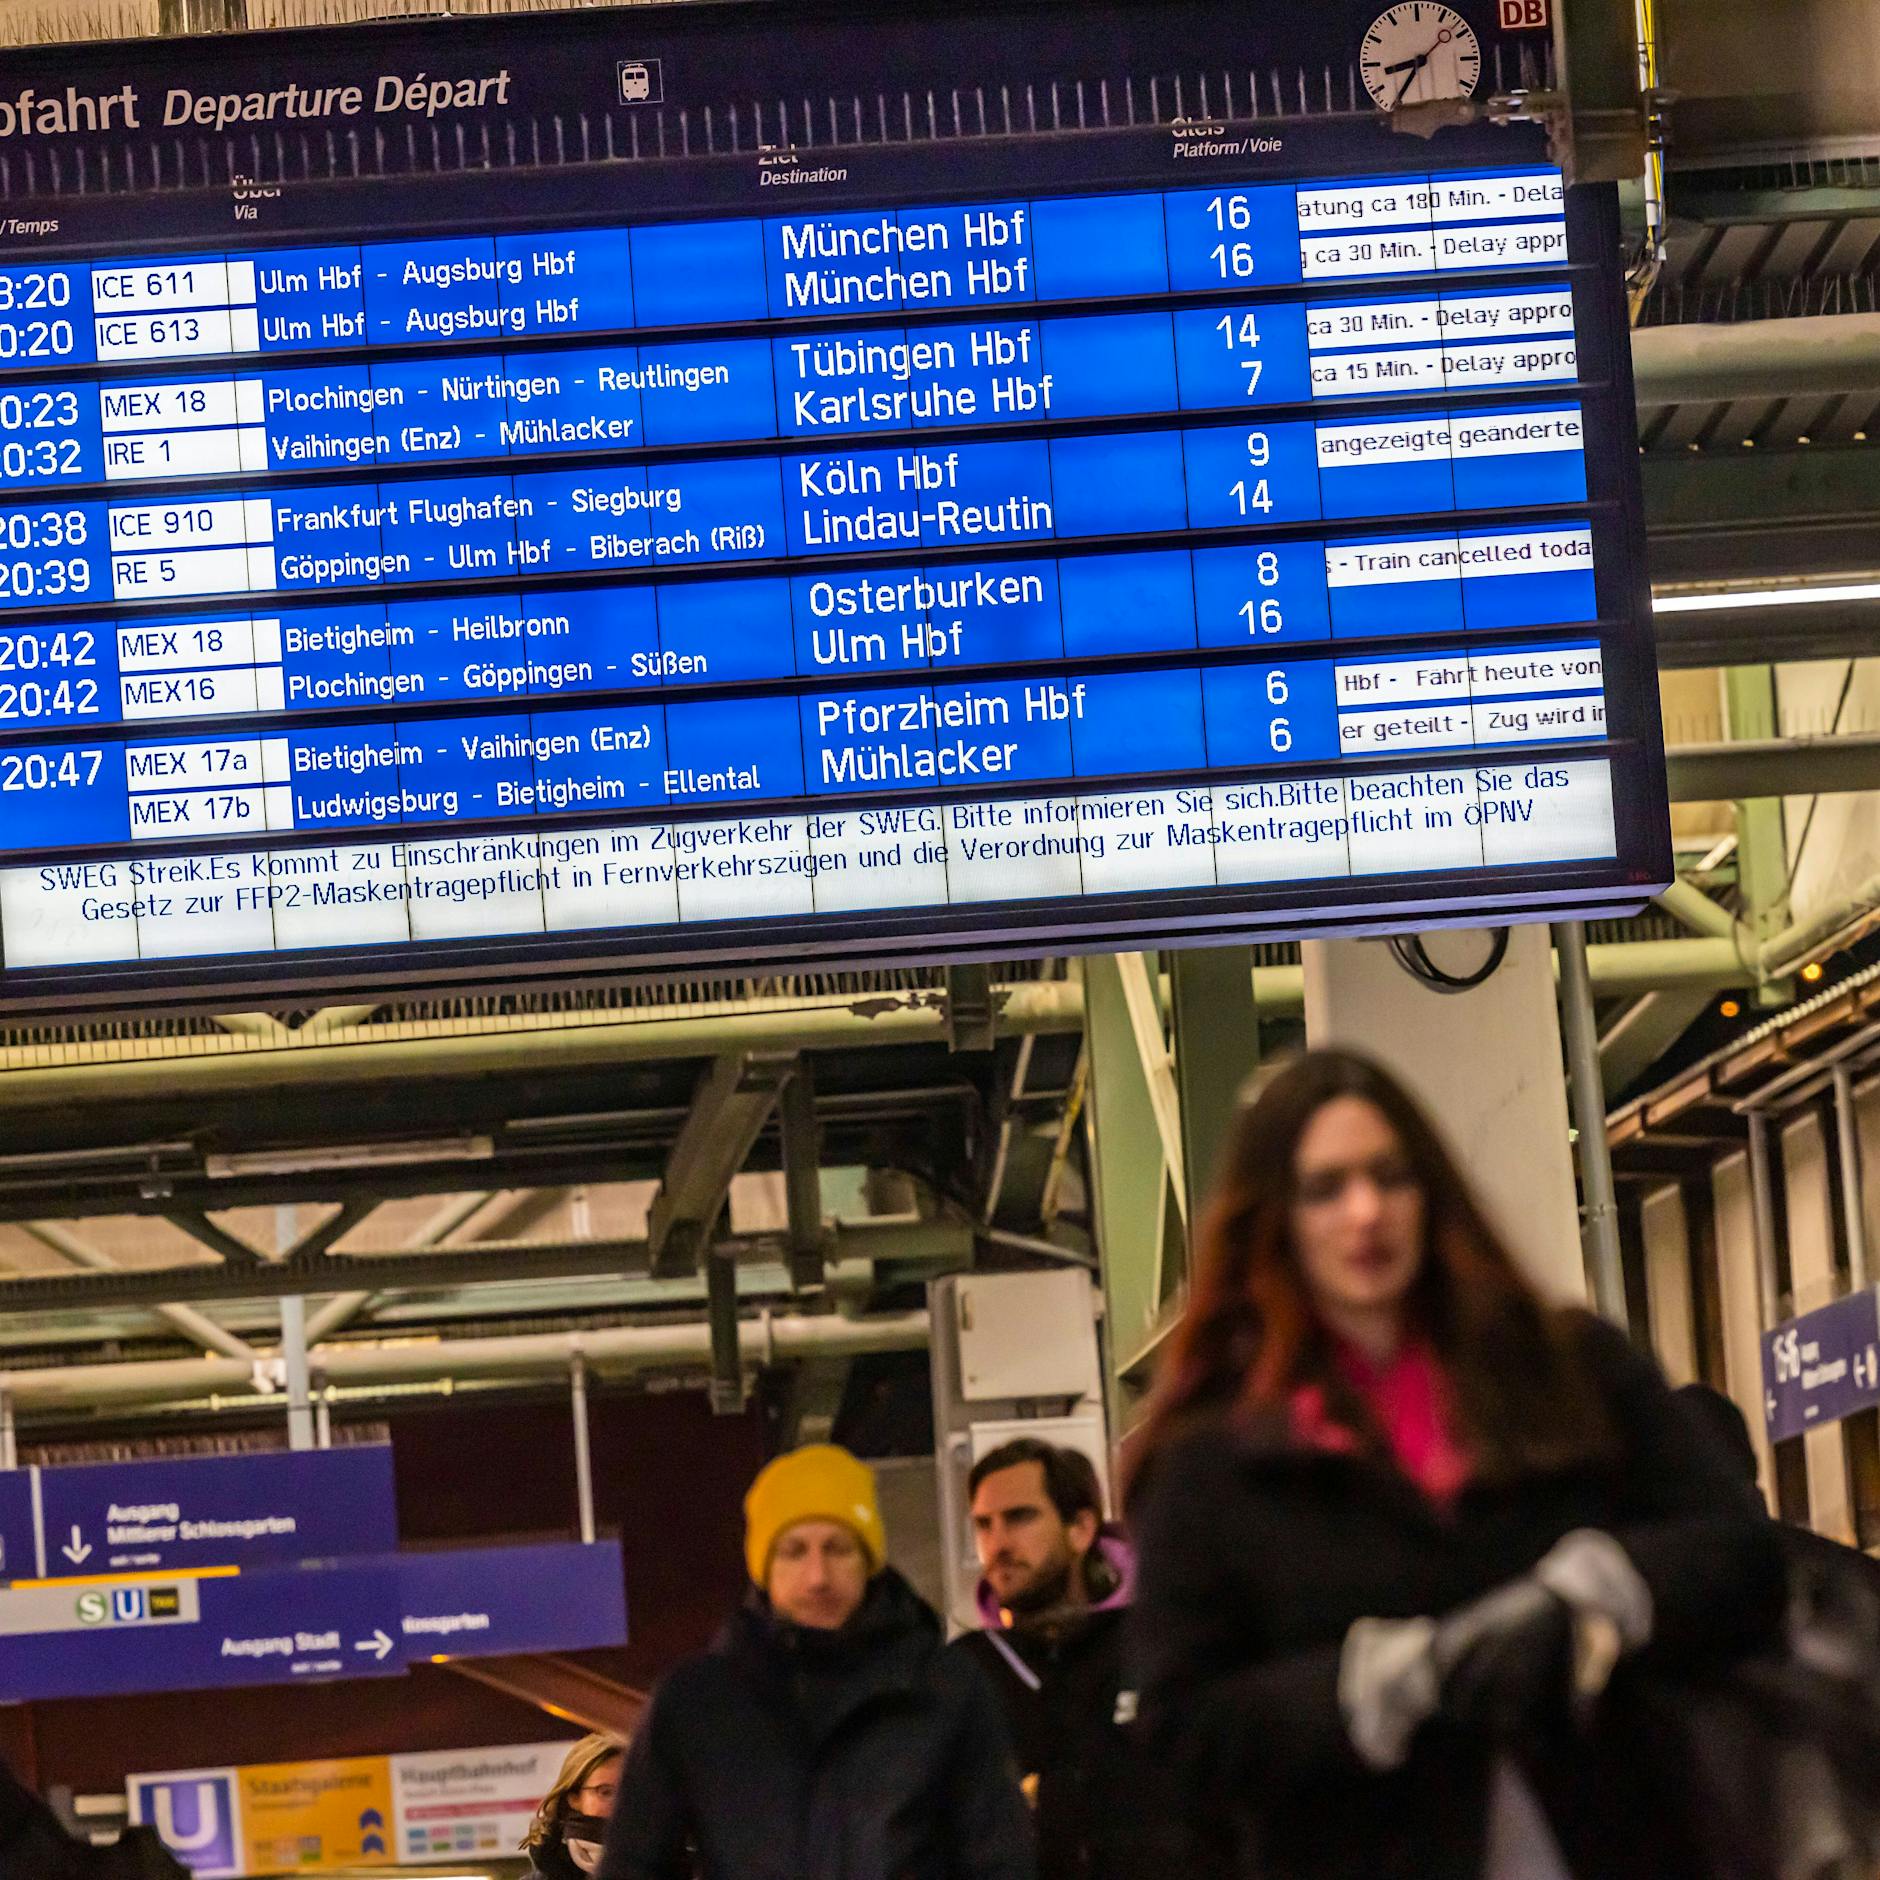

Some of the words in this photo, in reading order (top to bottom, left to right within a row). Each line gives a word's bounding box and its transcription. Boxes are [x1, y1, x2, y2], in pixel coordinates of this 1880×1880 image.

[1503, 0, 1543, 25] DB
[163, 81, 363, 132] Departure
[375, 69, 511, 119] Départ
[760, 167, 847, 186] Destination
[234, 205, 258, 220] Via
[1207, 196, 1250, 230] 16
[1372, 198, 1396, 212] ca
[1406, 192, 1440, 210] 180
[1450, 190, 1490, 206] Min.
[782, 220, 948, 259] München
[965, 210, 1024, 247] Hbf
[1316, 249, 1340, 263] ca
[1349, 244, 1372, 260] 30
[1380, 242, 1422, 259] Min.
[1444, 237, 1507, 255] Delay
[261, 270, 307, 293] Ulm
[319, 265, 361, 289] Hbf
[403, 258, 522, 288] Augsburg
[533, 251, 575, 275] Hbf
[1211, 243, 1253, 277] 16
[95, 274, 135, 299] ICE
[146, 271, 195, 295] 611
[786, 267, 951, 306] München
[968, 258, 1027, 294] Hbf
[99, 323, 137, 347] ICE
[150, 319, 200, 343] 613
[264, 317, 310, 341] Ulm
[323, 312, 364, 337] Hbf
[406, 305, 525, 335] Augsburg
[537, 298, 578, 323] Hbf
[1217, 314, 1260, 349] 14
[1340, 316, 1363, 333] 30
[1371, 313, 1413, 330] Min.
[1436, 308, 1500, 326] Delay
[791, 340, 954, 380] Tübingen
[971, 329, 1030, 366] Hbf
[1313, 368, 1337, 382] ca
[1346, 363, 1368, 379] 15
[1376, 361, 1418, 378] Min.
[1441, 355, 1504, 374] Delay
[269, 385, 403, 412] Plochingen
[443, 375, 559, 402] Nürtingen
[599, 364, 728, 391] Reutlingen
[1241, 361, 1262, 395] 7
[0, 392, 78, 429] 0:23
[105, 393, 160, 418] MEX
[176, 390, 205, 413] 18
[795, 384, 975, 425] Karlsruhe
[993, 375, 1052, 412] Hbf
[108, 443, 143, 465] IRE
[160, 441, 171, 462] 1
[272, 434, 389, 461] Vaihingen
[402, 425, 460, 451] (Enz)
[500, 416, 633, 445] Mühlacker
[1248, 433, 1269, 466] 9
[1321, 429, 1450, 455] angezeigte
[1459, 421, 1580, 448] geänderte
[801, 460, 881, 496] Köln
[898, 453, 958, 490] Hbf
[278, 502, 398, 531] Frankfurt
[410, 495, 532, 526] Flughafen
[572, 486, 680, 516] Siegburg
[1230, 480, 1272, 514] 14
[113, 513, 150, 537] ICE
[165, 510, 213, 534] 910
[804, 496, 1051, 544] Lindau-Reutin
[281, 553, 409, 583] Göppingen
[449, 545, 496, 568] Ulm
[508, 539, 550, 564] Hbf
[591, 530, 699, 559] Biberach
[711, 525, 764, 550] (Riß)
[1257, 552, 1278, 585] 8
[1355, 553, 1410, 571] Train
[1419, 544, 1530, 566] cancelled
[117, 562, 149, 583] RE
[161, 560, 175, 581] 5
[810, 572, 1042, 616] Osterburken
[1239, 599, 1282, 634] 16
[0, 631, 95, 671] 20:42
[122, 633, 178, 657] MEX
[193, 629, 222, 653] 18
[286, 623, 413, 654] Bietigheim
[453, 615, 569, 640] Heilbronn
[813, 629, 885, 664] Ulm
[902, 621, 962, 658] Hbf
[125, 679, 215, 705] MEX16
[290, 672, 424, 699] Plochingen
[464, 661, 592, 692] Göppingen
[632, 651, 706, 676] Süßen
[1267, 671, 1288, 704] 6
[1345, 673, 1380, 691] Hbf
[1486, 662, 1554, 681] heute
[0, 679, 98, 718] 20:42
[819, 692, 1008, 735] Pforzheim
[1025, 684, 1085, 721] Hbf
[1270, 718, 1291, 751] 6
[1342, 725, 1364, 739] er
[1374, 716, 1453, 741] geteilt
[1489, 712, 1528, 731] Zug
[1536, 706, 1585, 725] wird
[130, 752, 187, 777] MEX
[201, 749, 247, 773] 17a
[295, 742, 422, 773] Bietigheim
[462, 734, 579, 761] Vaihingen
[591, 725, 650, 751] (Enz)
[822, 740, 1017, 783] Mühlacker
[2, 751, 102, 790] 20:47
[298, 789, 457, 820] Ludwigsburg
[497, 776, 624, 807] Bietigheim
[664, 765, 760, 794] Ellental
[41, 866, 117, 891] SWEG
[130, 855, 240, 884] Streik.Es
[253, 848, 338, 877] kommt
[352, 849, 381, 870] zu
[392, 833, 600, 868] Einschränkungen
[611, 831, 638, 854] im
[650, 819, 793, 854] Zugverkehr
[807, 814, 846, 839] der
[860, 807, 942, 837] SWEG.
[953, 804, 1012, 830] Bitte
[1024, 795, 1165, 826] informieren
[1176, 789, 1213, 815] Sie
[1226, 781, 1338, 811] sich.Bitte
[1351, 773, 1464, 801] beachten
[1476, 768, 1511, 793] Sie
[1524, 764, 1570, 789] das
[133, 800, 190, 824] MEX
[204, 797, 250, 820] 17b
[82, 894, 172, 922] Gesetz
[185, 892, 223, 914] zur
[236, 868, 560, 912] FFP2-Maskentragepflicht
[572, 864, 593, 888] in
[604, 847, 846, 888] Fernverkehrszügen
[858, 843, 902, 869] und
[913, 839, 948, 864] die
[961, 829, 1104, 863] Verordnung
[1116, 830, 1154, 852] zur
[1167, 810, 1414, 847] Maskentragepflicht
[1424, 806, 1452, 830] im
[1464, 798, 1533, 826] ÖPNV
[80, 1593, 104, 1622] S
[117, 1590, 143, 1621] U
[221, 1637, 294, 1657] Ausgang
[295, 1631, 340, 1651] Stadt
[154, 1781, 218, 1849] U
